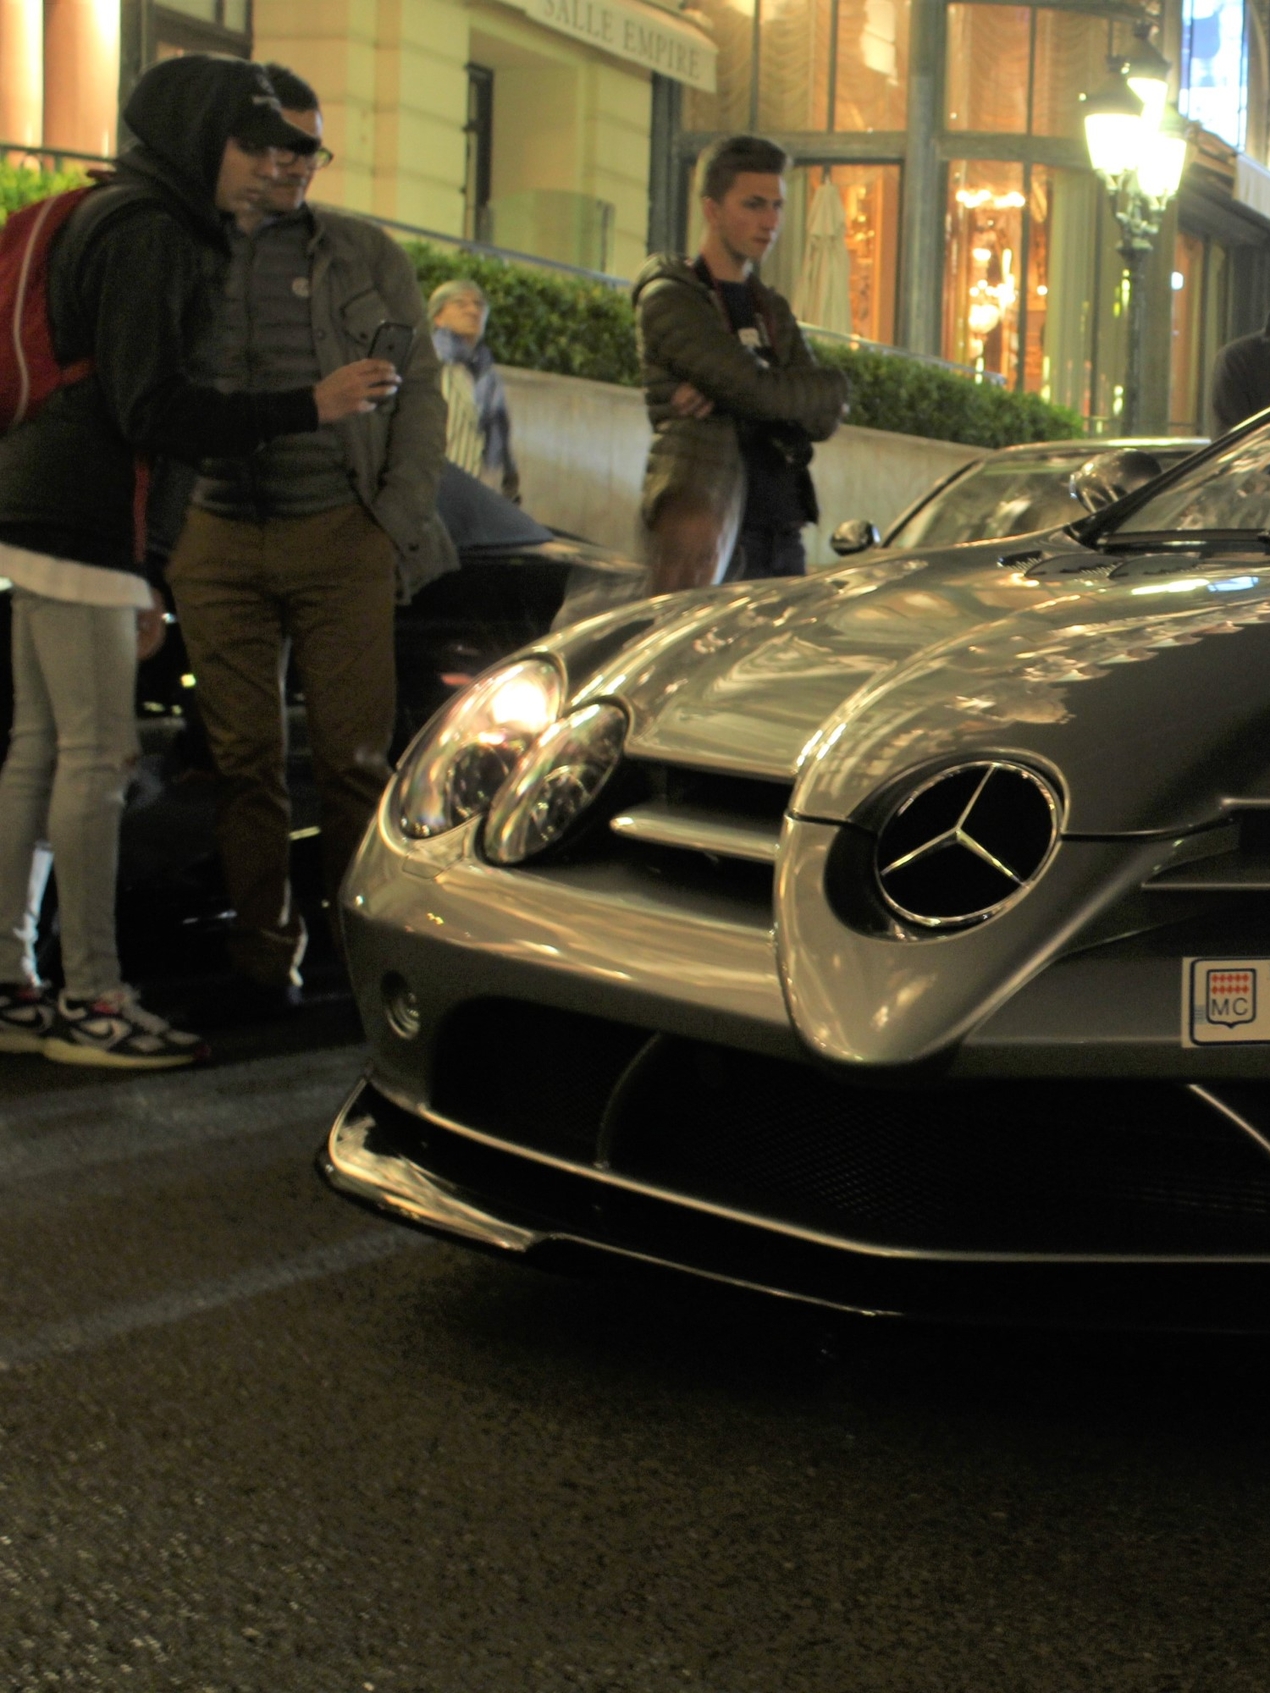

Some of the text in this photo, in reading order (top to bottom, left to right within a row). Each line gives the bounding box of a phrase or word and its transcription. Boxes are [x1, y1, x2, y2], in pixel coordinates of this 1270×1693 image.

[544, 0, 701, 81] SALLE EMPIRE
[1211, 998, 1248, 1016] MC
